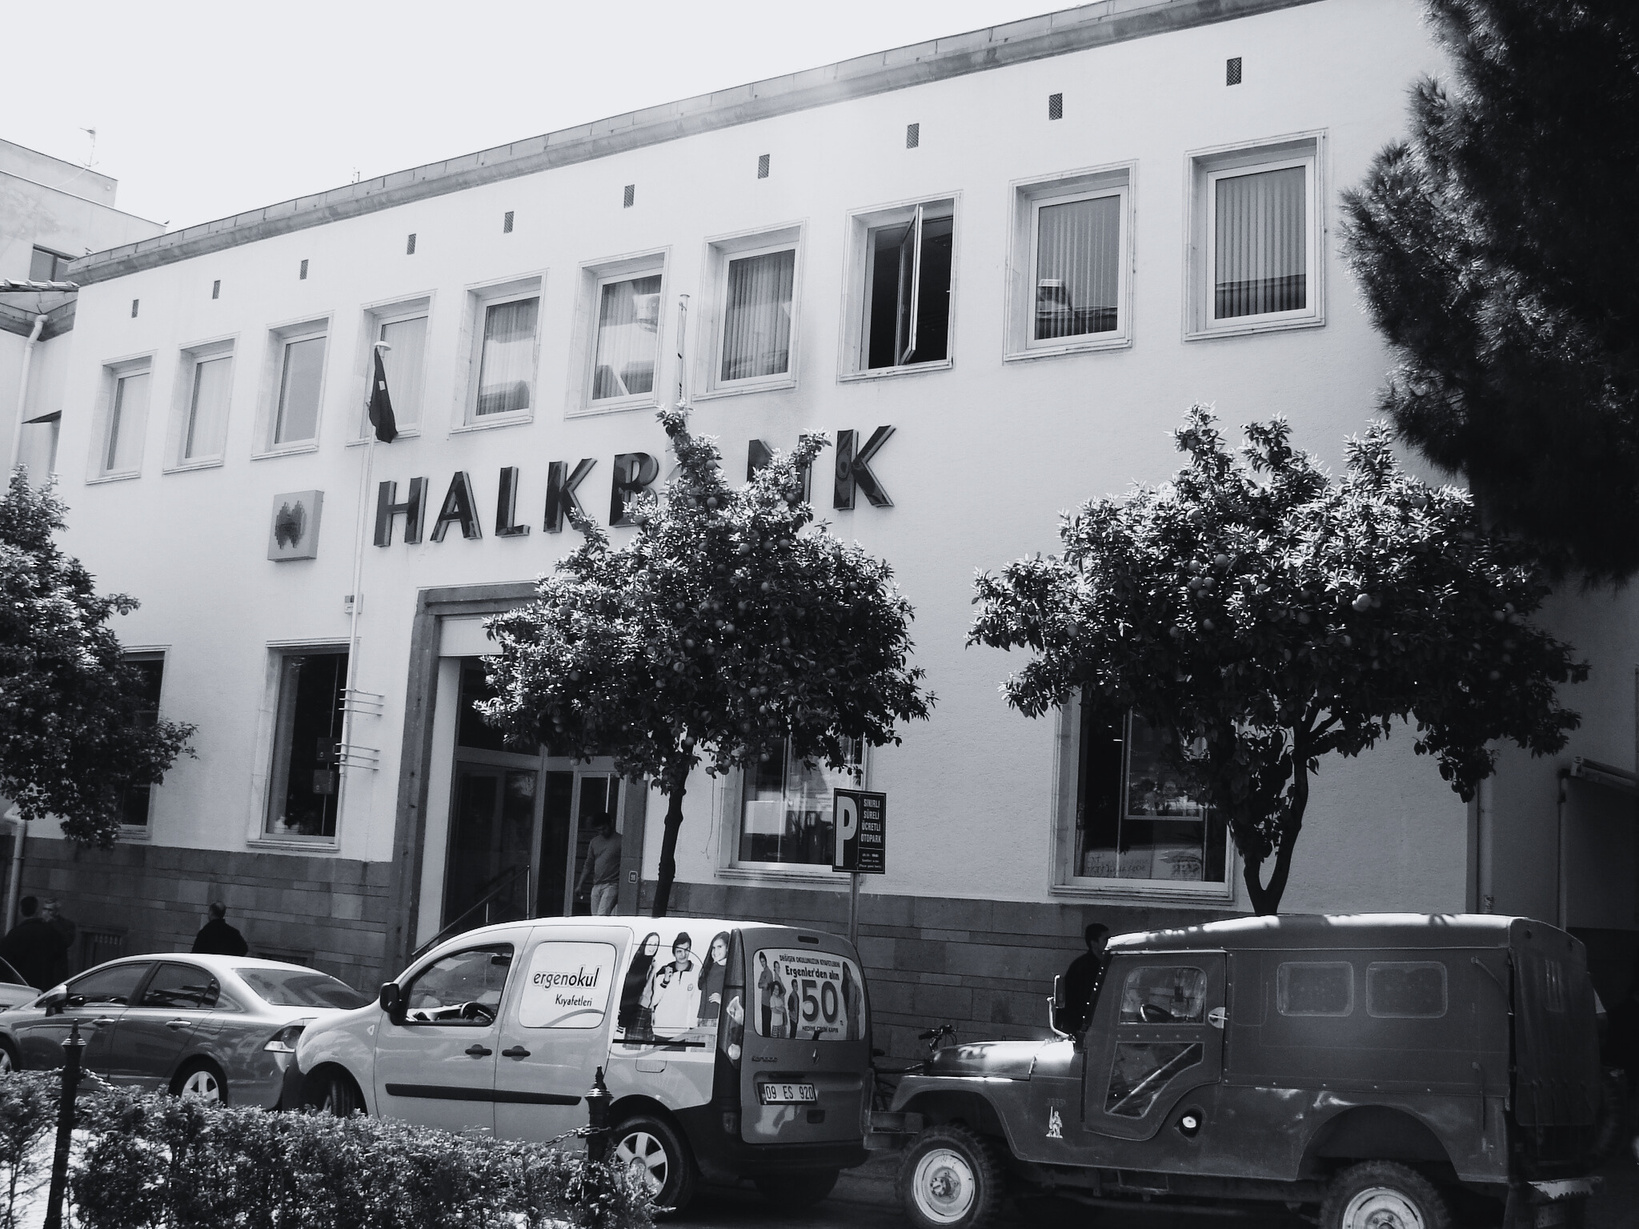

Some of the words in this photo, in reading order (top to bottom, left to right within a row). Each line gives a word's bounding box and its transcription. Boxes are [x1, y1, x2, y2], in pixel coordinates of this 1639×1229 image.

[373, 424, 896, 547] HALKBK
[835, 796, 858, 867] P
[860, 833, 882, 843] OTOPARK
[533, 966, 600, 988] ergenokul
[785, 965, 828, 979] Ergenler'den
[554, 993, 593, 1008] Kıyafetleri
[801, 978, 839, 1024] 50
[765, 1086, 777, 1099] 09
[783, 1085, 794, 1099] ES
[799, 1086, 814, 1100] 920
